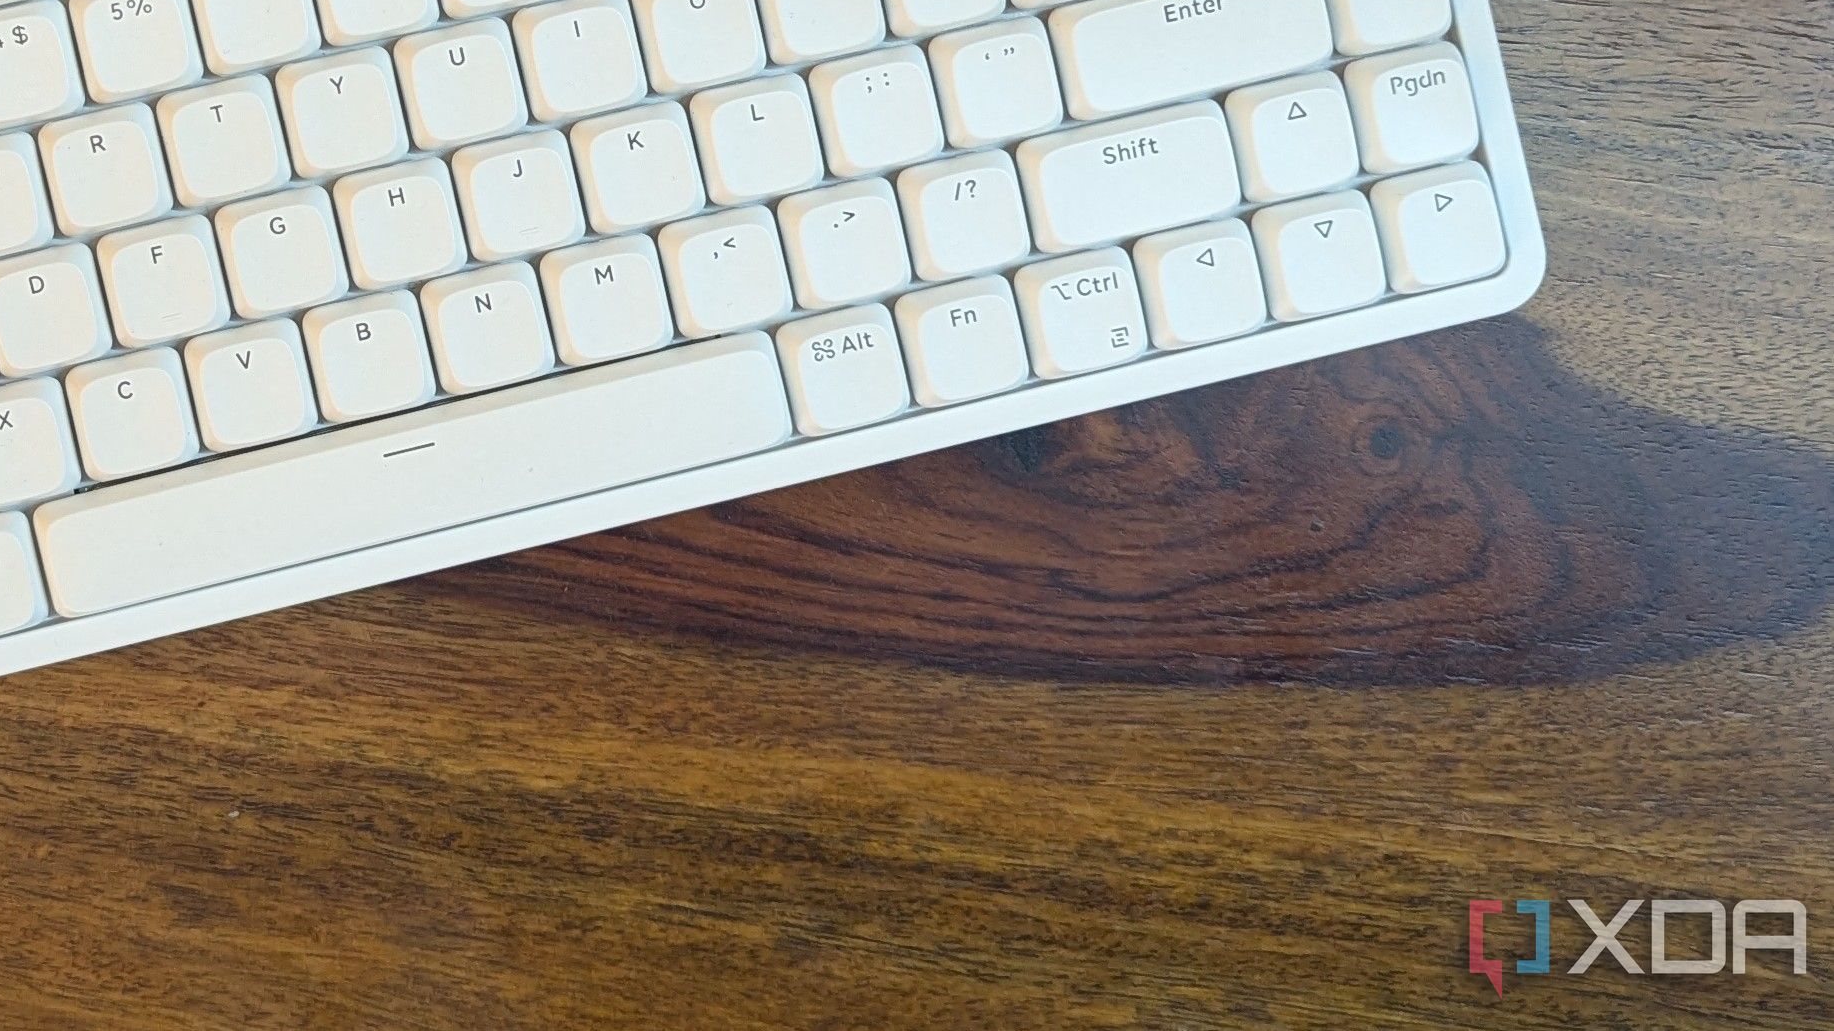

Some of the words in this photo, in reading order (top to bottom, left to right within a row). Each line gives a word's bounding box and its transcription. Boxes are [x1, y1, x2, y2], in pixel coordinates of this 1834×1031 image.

[11, 24, 29, 46] $
[448, 46, 466, 67] U
[329, 75, 344, 95] Y
[1389, 69, 1447, 97] Pgdn
[209, 104, 224, 124] T
[749, 103, 765, 122] L
[89, 134, 107, 154] R
[626, 130, 645, 151] K
[1102, 137, 1160, 165] Shift
[512, 158, 524, 179] J
[387, 186, 406, 208] H
[268, 216, 287, 236] G
[150, 244, 164, 265] F
[27, 275, 46, 295] D
[593, 264, 615, 286] M
[1076, 271, 1119, 297] Ctrl
[474, 292, 493, 314] N
[949, 307, 978, 328] Fn
[355, 322, 372, 342] B
[841, 332, 875, 355] Alt
[235, 350, 252, 370] V
[116, 380, 134, 400] C
